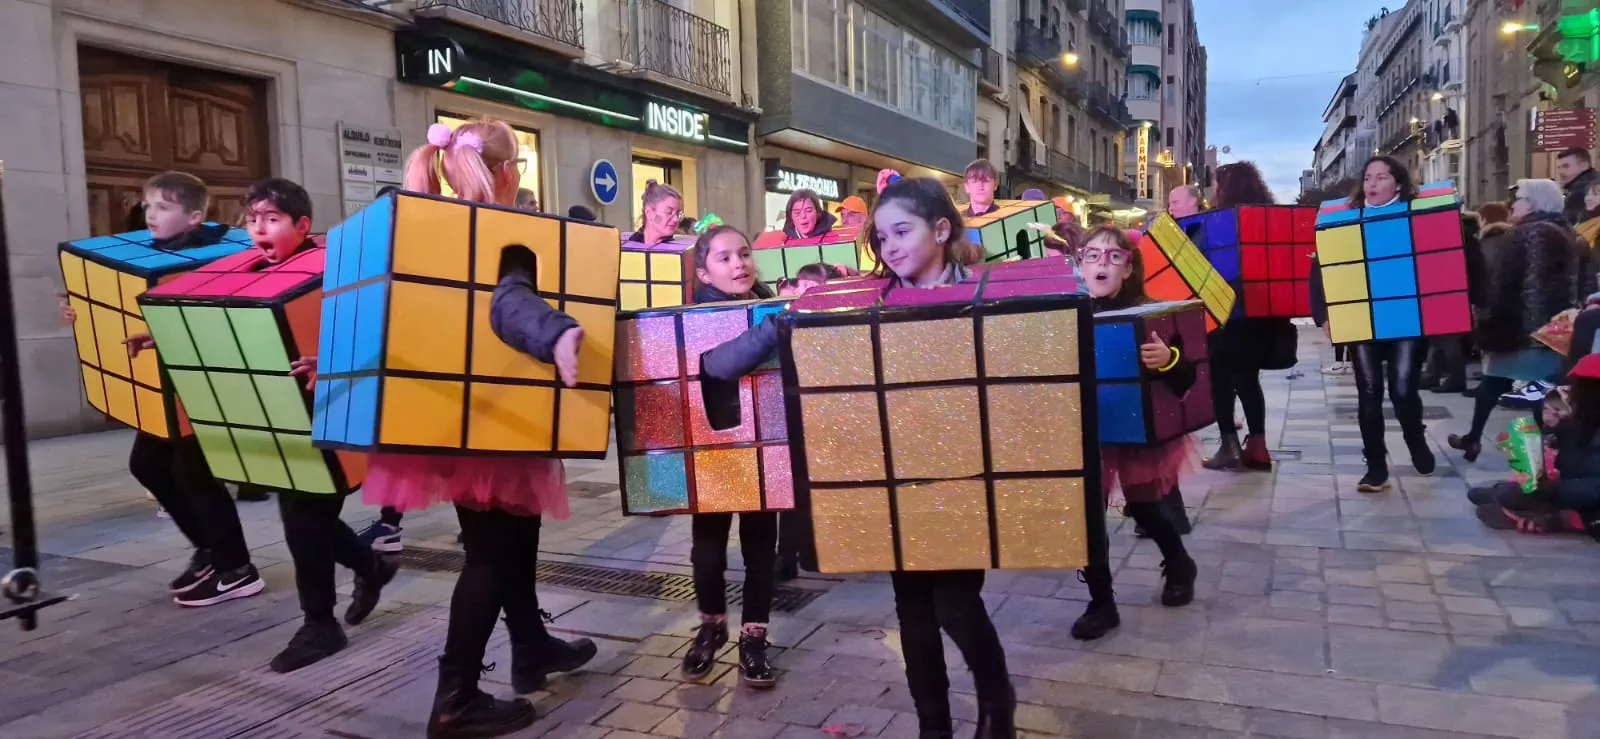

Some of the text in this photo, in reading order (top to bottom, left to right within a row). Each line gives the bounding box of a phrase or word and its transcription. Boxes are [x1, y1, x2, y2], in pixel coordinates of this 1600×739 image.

[428, 47, 452, 75] IN
[648, 101, 705, 141] INSIDE
[1138, 127, 1146, 197] FARMACIA
